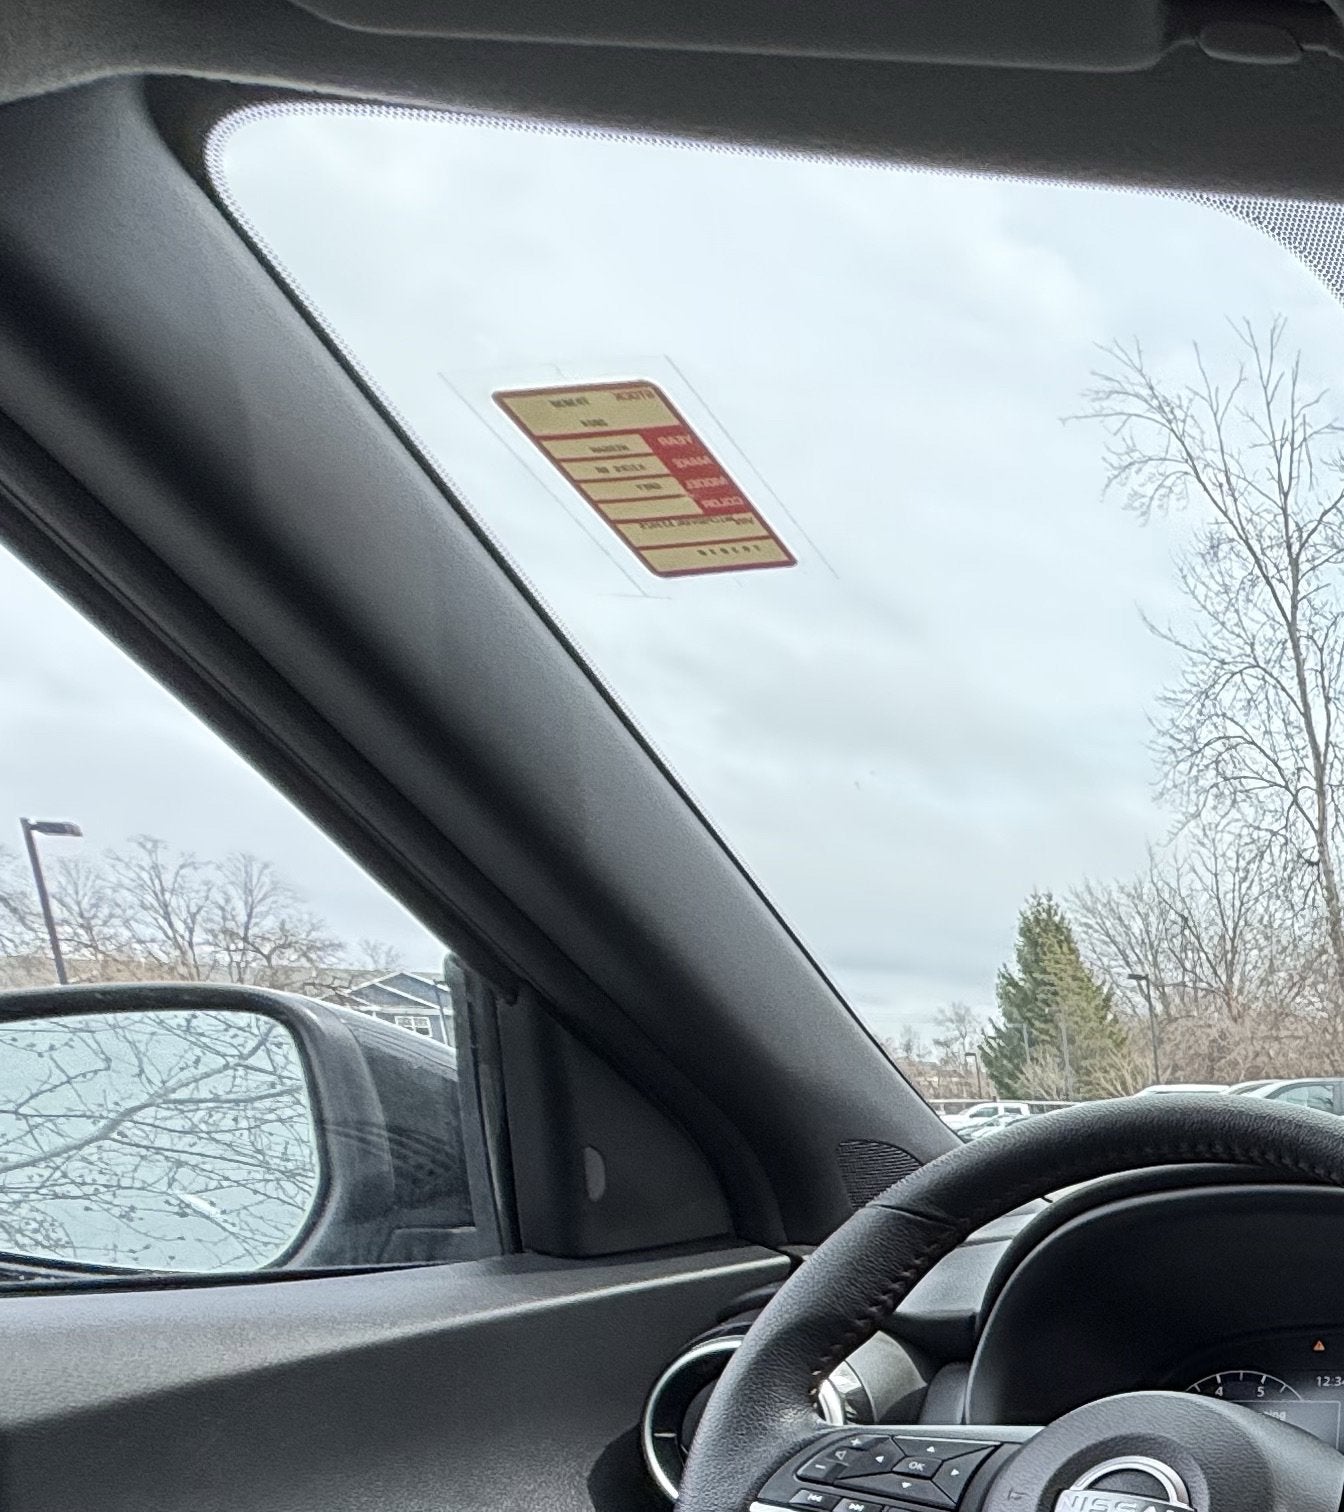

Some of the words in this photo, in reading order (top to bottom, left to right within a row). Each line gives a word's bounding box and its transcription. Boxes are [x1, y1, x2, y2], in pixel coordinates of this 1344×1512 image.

[1214, 1386, 1224, 1397] 4
[1256, 1386, 1266, 1397] 5
[908, 1460, 926, 1472] OK
